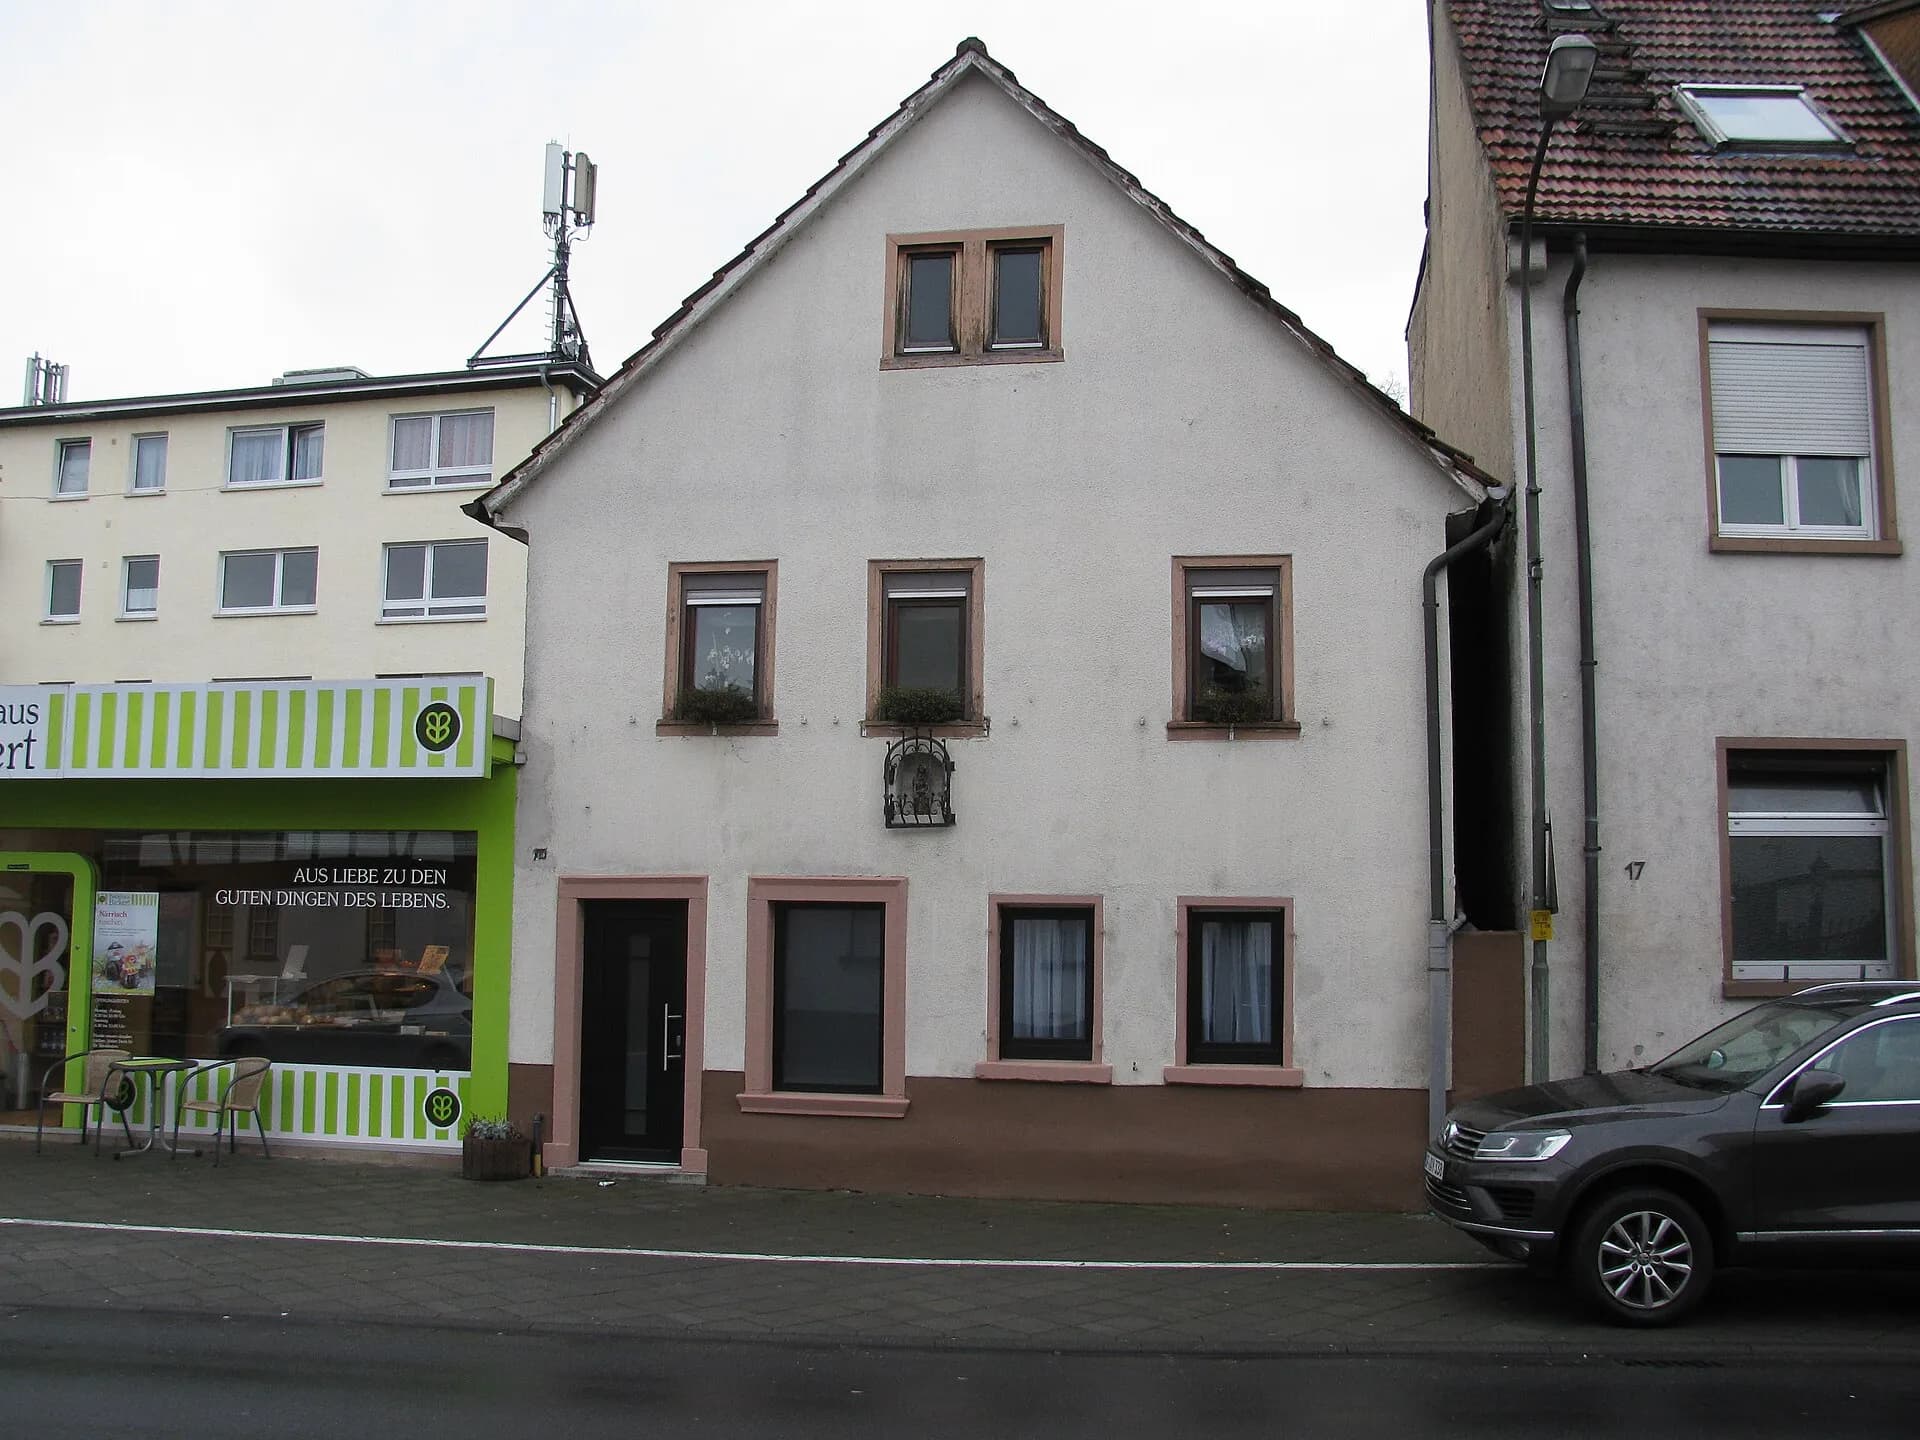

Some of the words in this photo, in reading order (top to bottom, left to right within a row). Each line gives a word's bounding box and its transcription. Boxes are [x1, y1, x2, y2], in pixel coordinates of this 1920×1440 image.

[293, 868, 329, 884] AUS
[333, 868, 379, 884] LIEBE
[383, 869, 406, 885] ZU
[410, 869, 447, 885] DEN
[1624, 861, 1646, 880] 17
[215, 889, 272, 906] GUTEN
[275, 890, 340, 907] DINGEN
[344, 892, 377, 908] DES
[380, 892, 450, 909] LEBENS.
